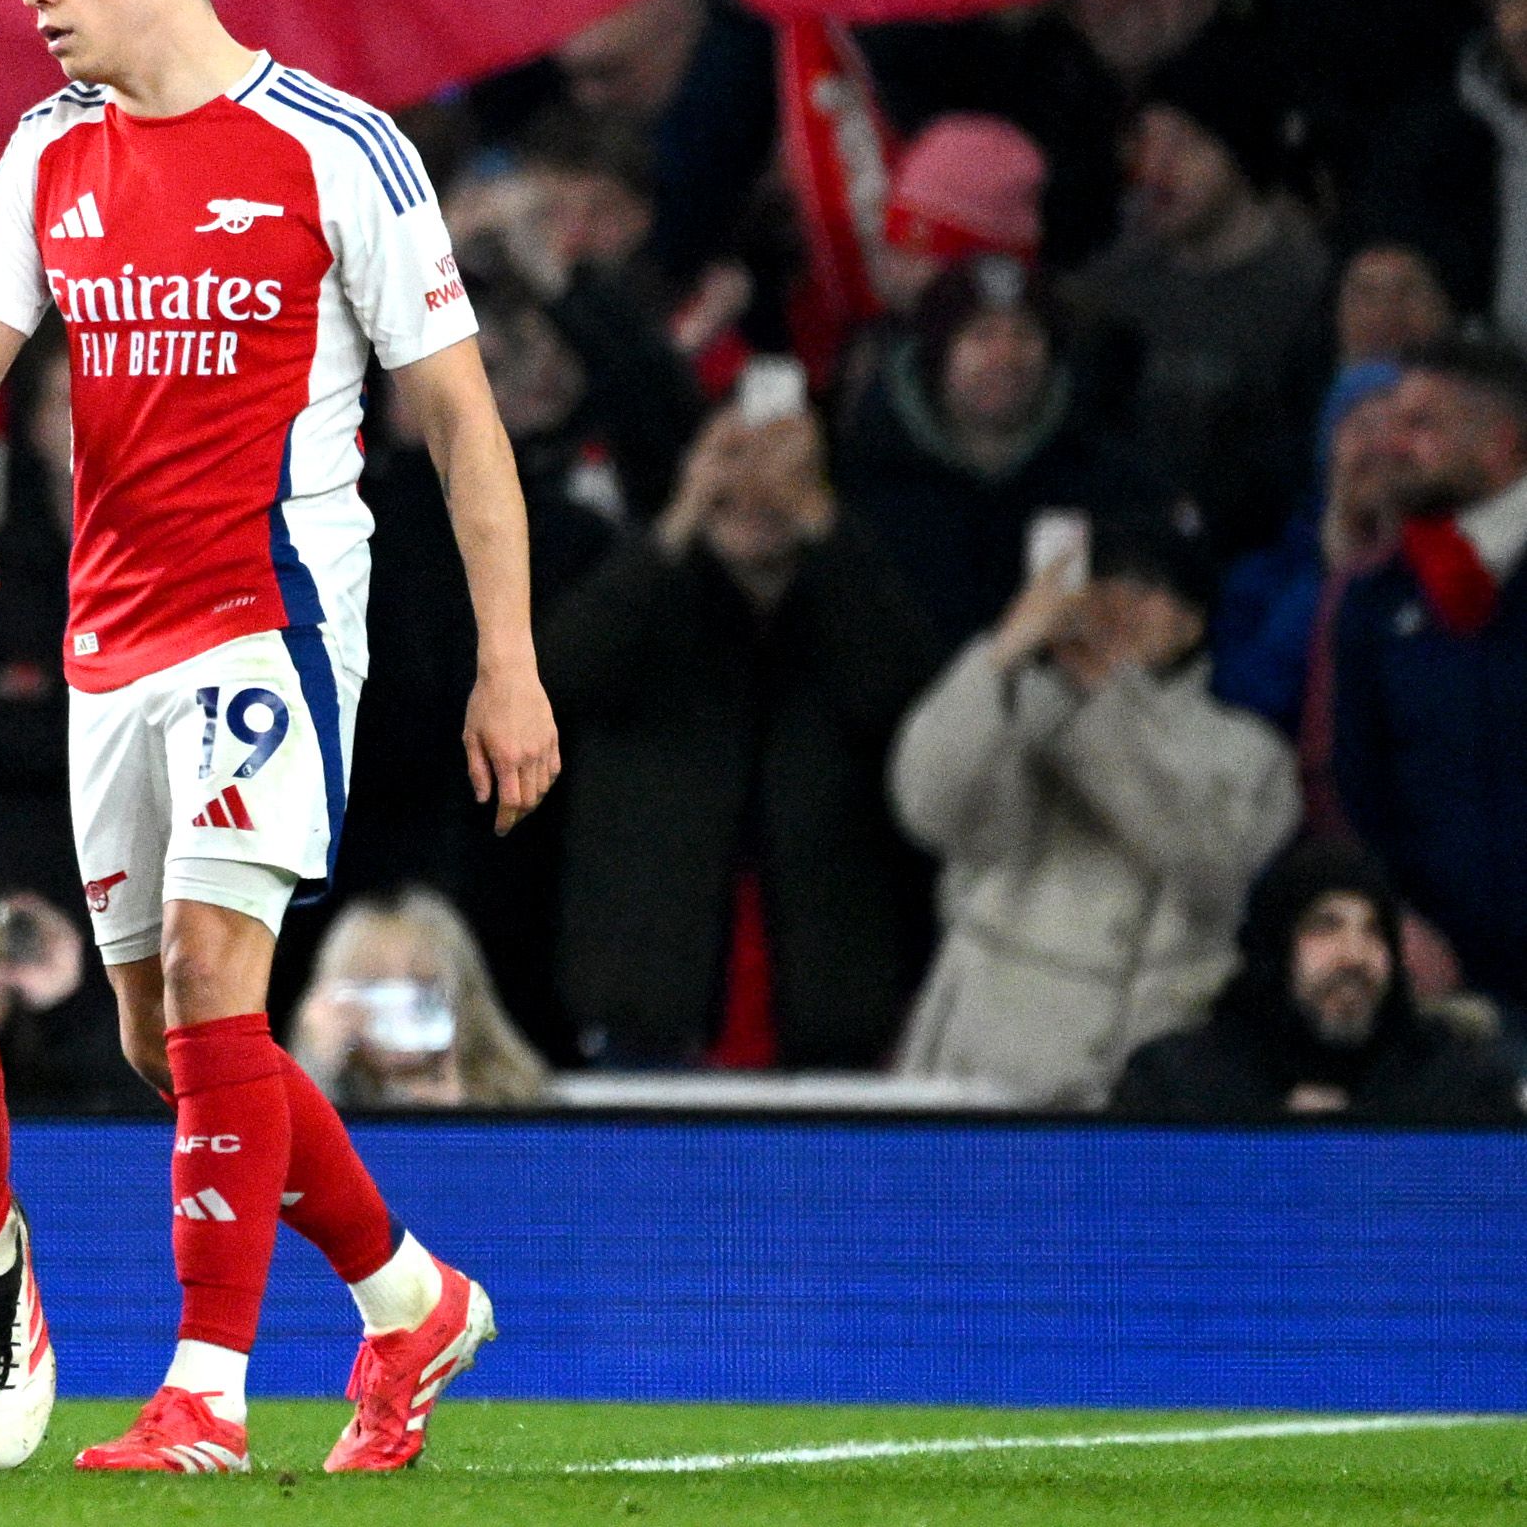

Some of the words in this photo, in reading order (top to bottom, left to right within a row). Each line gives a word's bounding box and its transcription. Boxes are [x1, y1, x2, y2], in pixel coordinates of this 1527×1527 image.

[46, 263, 282, 323] Emirates
[80, 332, 118, 377] FLY
[128, 330, 239, 376] BETTER
[196, 686, 290, 780] 19
[174, 1134, 242, 1155] AFC
